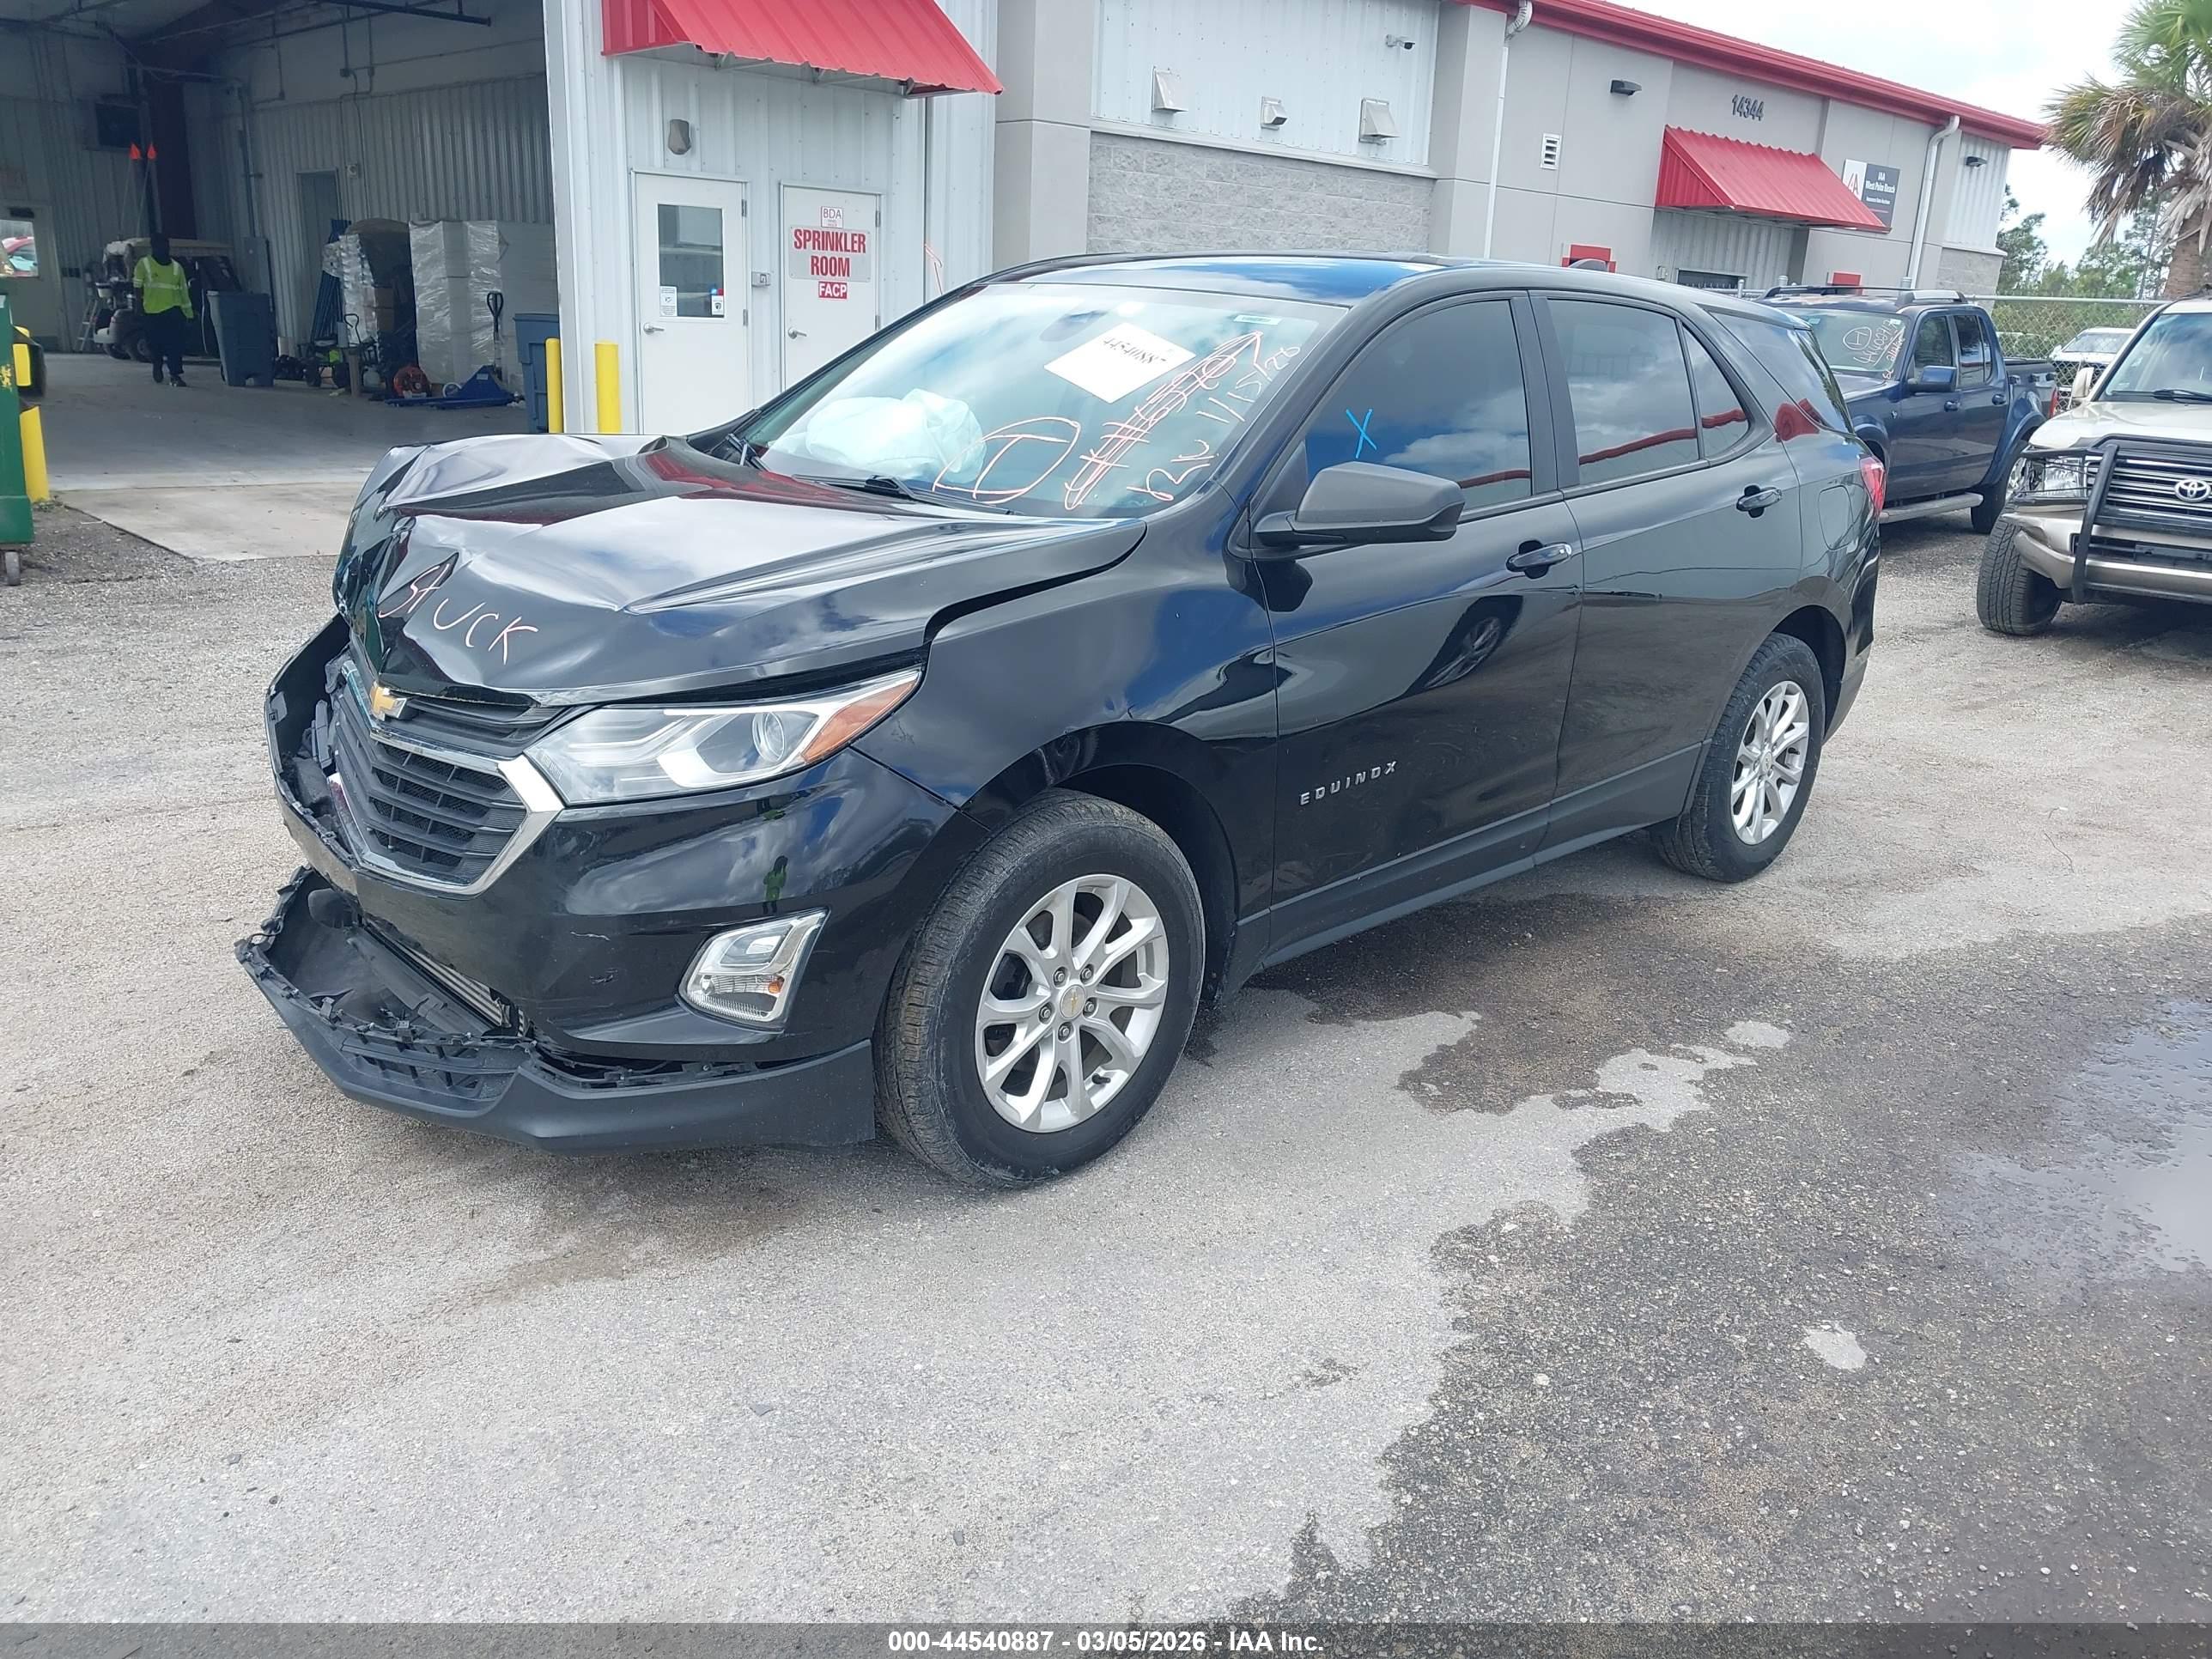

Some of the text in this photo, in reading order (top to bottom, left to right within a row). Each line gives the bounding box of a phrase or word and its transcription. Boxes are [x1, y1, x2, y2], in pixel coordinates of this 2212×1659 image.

[1732, 94, 1764, 121] 14344
[823, 208, 842, 219] BDA
[793, 228, 866, 253] SPRINKLER
[811, 255, 850, 277] ROOM
[819, 283, 847, 297] FACP
[1299, 760, 1397, 805] EQUINOX
